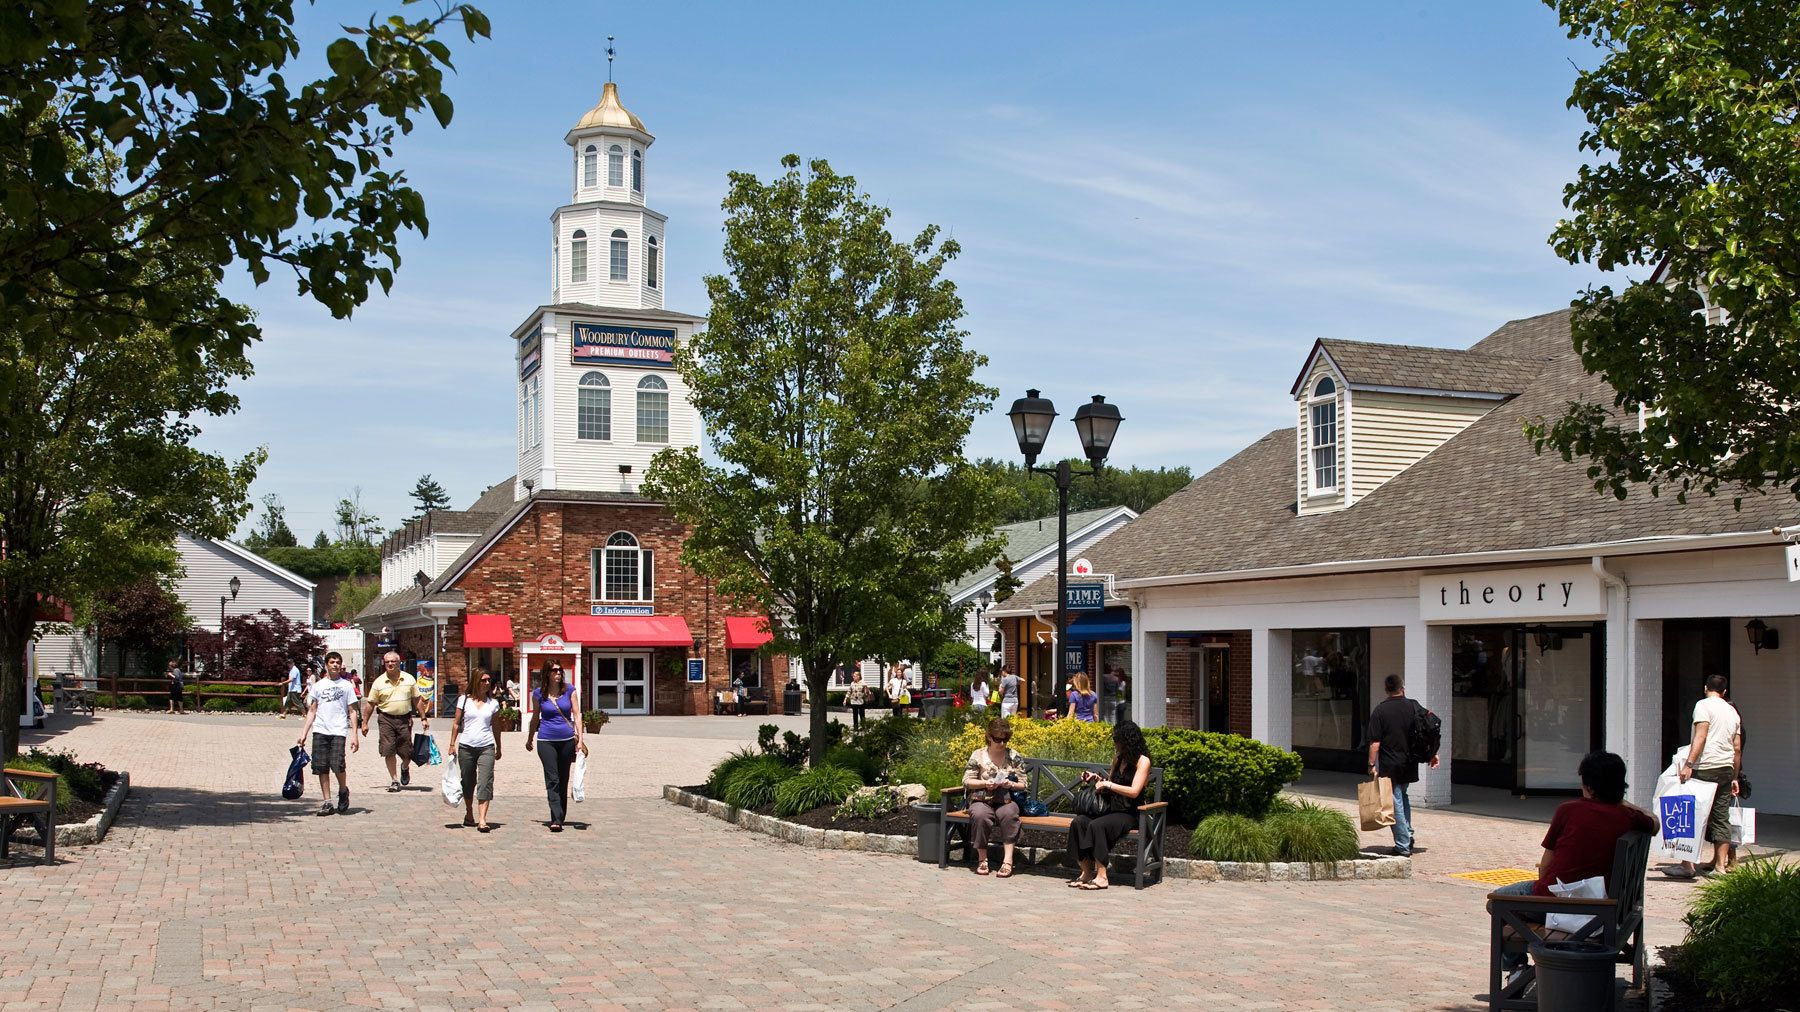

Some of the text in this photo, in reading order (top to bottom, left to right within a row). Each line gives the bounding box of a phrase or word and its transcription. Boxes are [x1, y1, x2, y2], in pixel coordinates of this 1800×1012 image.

[578, 327, 672, 348] WOODBURY COMMON
[590, 346, 659, 359] PREMIUM OUTLETS
[1066, 590, 1101, 601] TIME
[1440, 580, 1573, 608] theory
[604, 607, 650, 615] Information
[1066, 651, 1082, 665] IME
